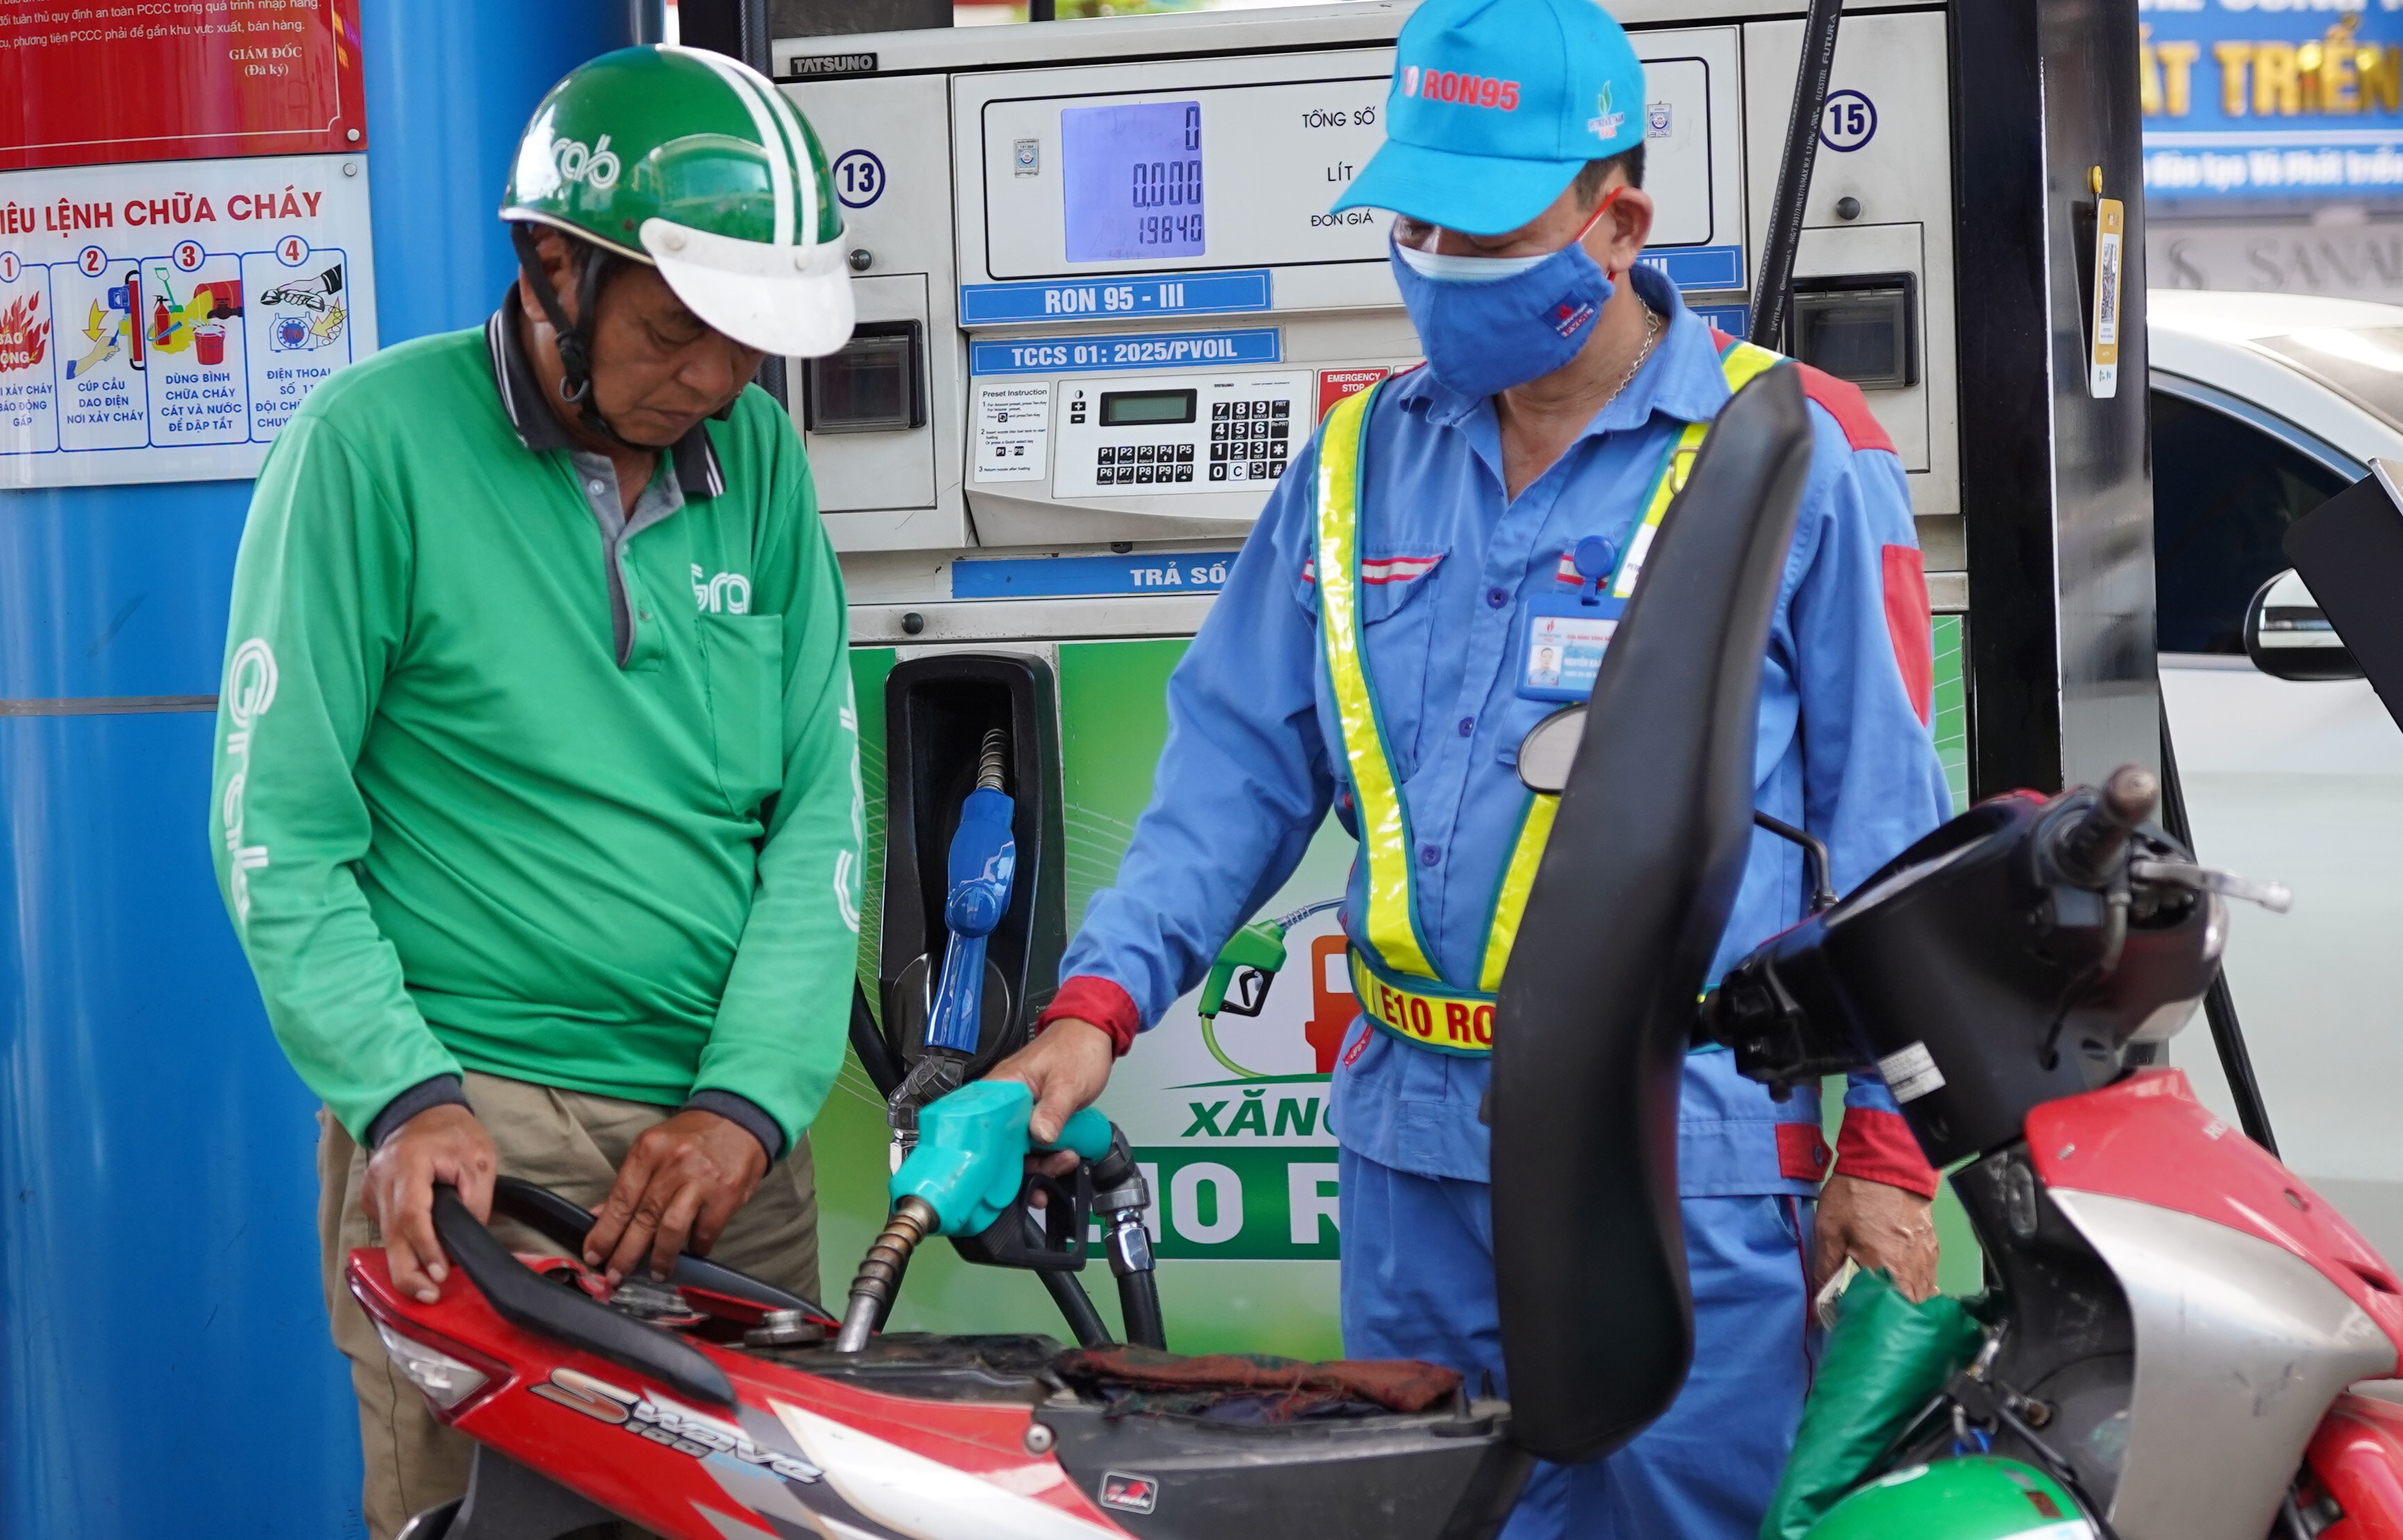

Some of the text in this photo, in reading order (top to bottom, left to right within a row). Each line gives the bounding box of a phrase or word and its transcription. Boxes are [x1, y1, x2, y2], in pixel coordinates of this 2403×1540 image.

[13, 14, 32, 25] tuân
[35, 10, 49, 23] thủ
[52, 13, 69, 23] quy
[72, 9, 92, 22] định
[96, 9, 108, 18] an
[111, 6, 134, 17] toàn
[137, 3, 171, 15] PCCC
[174, 3, 202, 14] trong
[206, 1, 227, 13] quá
[14, 35, 47, 49] phương
[50, 32, 67, 45] tiện
[70, 29, 102, 42] PCCC
[105, 26, 127, 42] phải
[130, 24, 144, 38] để
[147, 24, 168, 39] gần
[170, 23, 190, 35] khu
[194, 24, 213, 37] vực
[217, 20, 244, 33] xuất,
[247, 20, 270, 32] bán
[272, 19, 305, 32] hàng.
[1822, 13, 1836, 64] FUTURA
[229, 42, 302, 60] GIÁM ĐỐC
[270, 63, 288, 77] ký)
[794, 55, 872, 73] TATSUNO
[1423, 68, 1520, 112] RON95
[1816, 68, 1827, 101] FLEXSTEEL
[1302, 106, 1376, 128] TỔNG SỐ
[1830, 104, 1866, 135] 15
[1185, 106, 1199, 151] 0
[551, 133, 621, 190] rab
[843, 163, 874, 192] 13
[1328, 161, 1353, 181] LÍT
[0, 183, 323, 238] IÊU LỆNH CHỮA CHÁY
[1347, 208, 1374, 225] GIÁ
[1139, 214, 1202, 244] 19840
[181, 245, 195, 267] 3
[285, 240, 299, 261] 4
[4, 257, 13, 277] 1
[87, 250, 99, 272] 2
[1045, 288, 1096, 313] RON
[1104, 286, 1134, 311] 95
[1159, 284, 1184, 308] III
[0, 350, 30, 368] ỘNG
[1011, 339, 1238, 367] TCCS 01: 2025/PVOIL
[165, 370, 230, 384] DÙNG BÌNH
[267, 368, 293, 382] ĐIỆN
[1327, 372, 1380, 383] EMERGENCY
[6, 384, 23, 395] XẢY
[26, 382, 53, 394] CHÁY
[78, 380, 99, 391] CÚP
[165, 386, 236, 400] CHỮA CHÁY
[280, 382, 295, 395] SỐ
[1008, 388, 1048, 397] Instruction
[1342, 384, 1365, 392] STOP
[79, 395, 129, 409] DAO ĐIỆN
[161, 403, 242, 416] CÁT VÀ NƯỚC
[255, 400, 276, 414] ĐỘI
[1216, 404, 1226, 415] 7
[1236, 403, 1246, 414] 8
[1256, 402, 1266, 413] 9
[89, 410, 110, 423] XẢY
[113, 409, 143, 422] CHÁY
[169, 418, 233, 433] ĐỂ DẬP TẮT
[1215, 423, 1225, 434] 4
[1236, 423, 1245, 434] 5
[1255, 423, 1264, 433] 6
[1101, 445, 1191, 457] P1 P2 P3 P4 P5
[1215, 442, 1264, 454] 1 2 3
[1100, 468, 1112, 477] P6
[1119, 468, 1132, 476] P7
[1139, 467, 1151, 475] P8
[1177, 466, 1191, 474] P10
[1213, 466, 1223, 477] 0
[1234, 466, 1242, 476] C
[1130, 560, 1228, 586] TRẢ SỐ
[690, 563, 751, 614] Gra
[1380, 984, 1496, 1045] E10 RO
[1288, 1162, 1339, 1244] R
